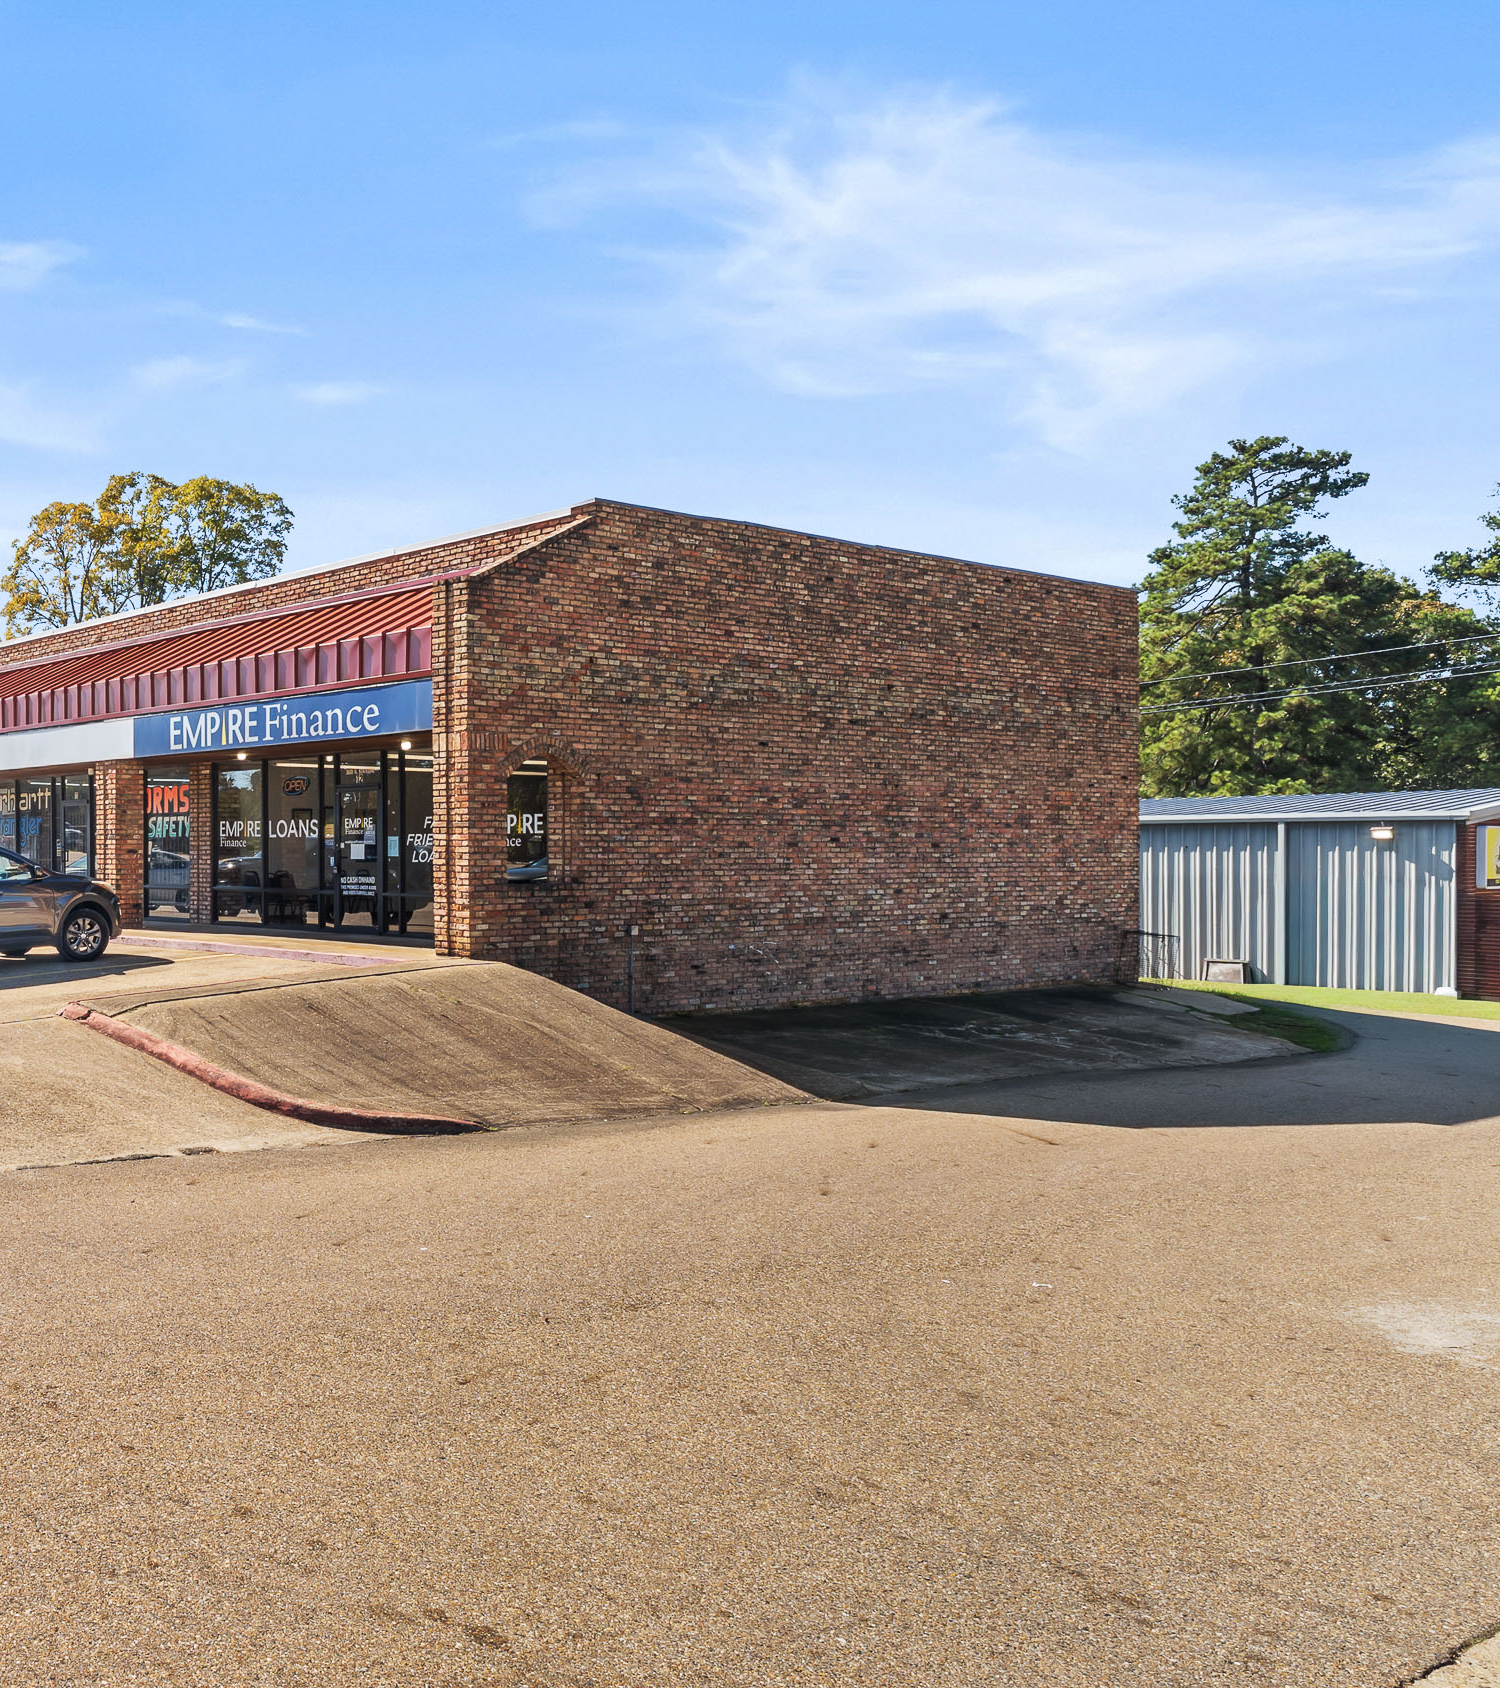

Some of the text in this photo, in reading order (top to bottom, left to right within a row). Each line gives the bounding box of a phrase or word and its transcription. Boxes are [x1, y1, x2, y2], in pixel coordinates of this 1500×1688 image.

[169, 703, 380, 750] EMPIRE Finance
[284, 780, 307, 792] OPEN
[148, 816, 190, 838] SAFETY
[219, 818, 261, 837] EMPIRE
[269, 819, 319, 838] LOANS
[345, 817, 373, 828] EMPIRE
[220, 837, 247, 848] Finance
